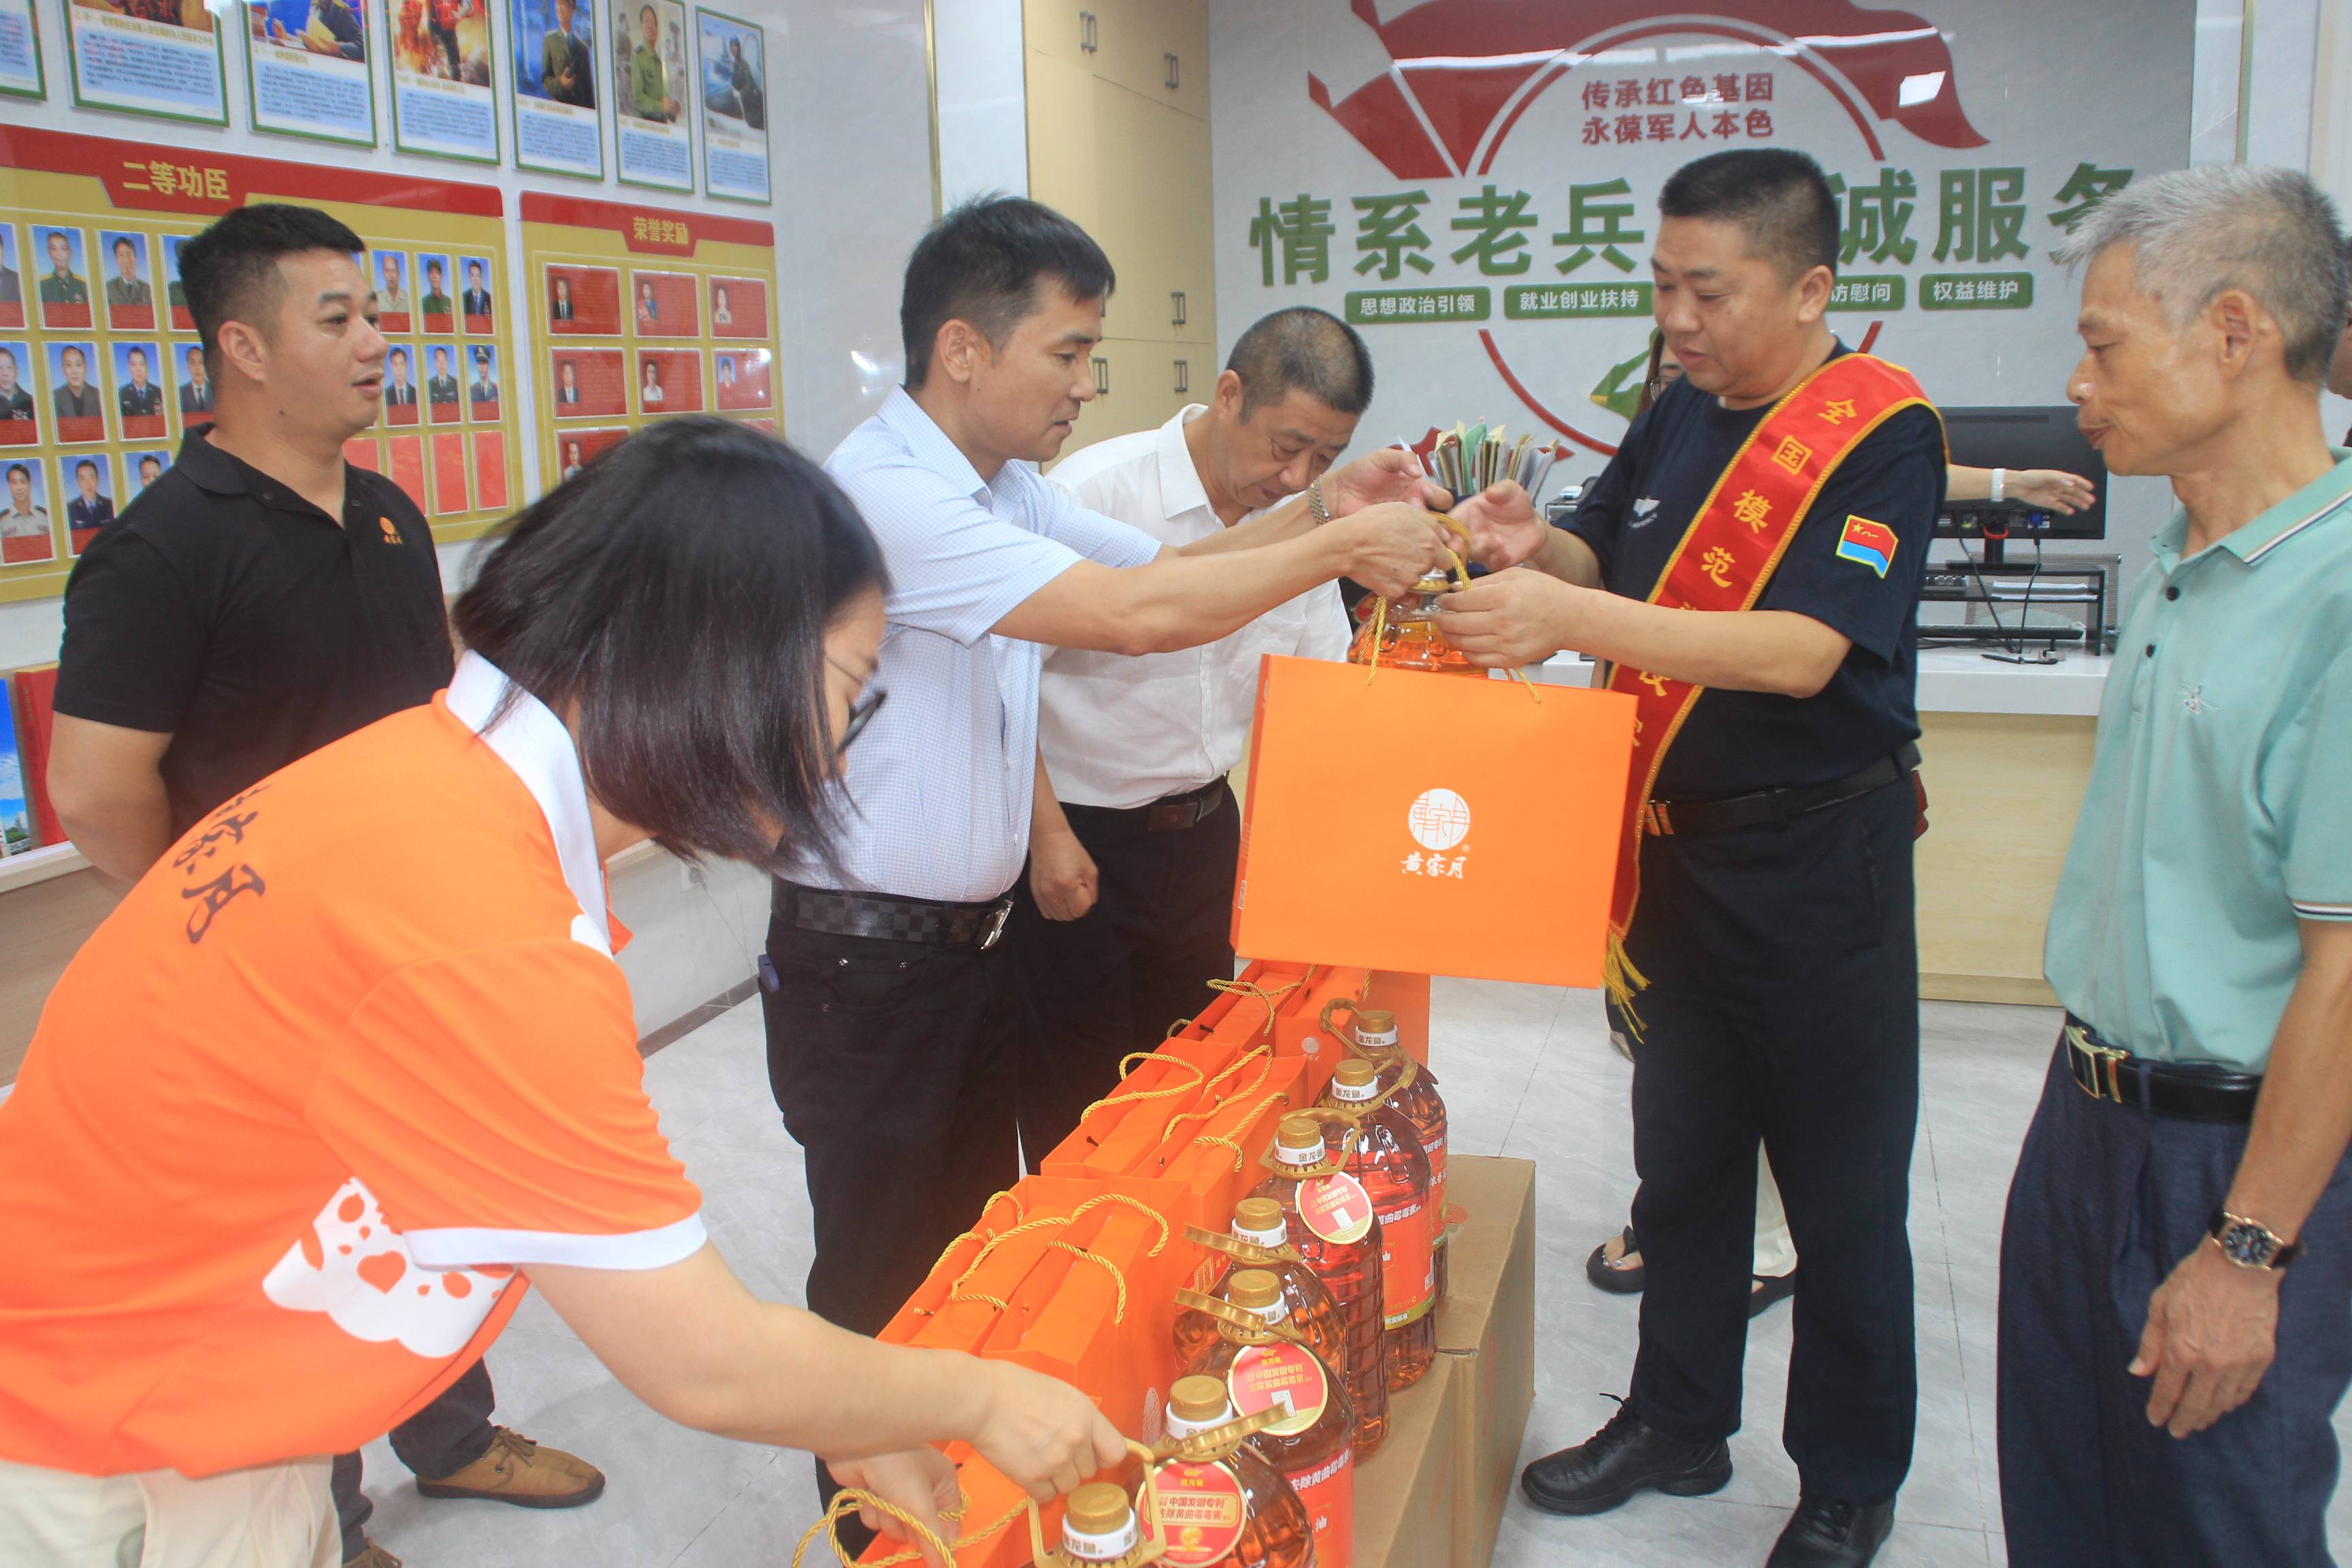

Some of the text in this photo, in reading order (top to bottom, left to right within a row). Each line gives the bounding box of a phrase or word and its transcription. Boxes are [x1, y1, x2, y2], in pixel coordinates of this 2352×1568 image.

[1582, 73, 1774, 110] 传承红色基因
[1582, 108, 1774, 145] 永葆军人本色
[122, 159, 229, 200] 二等功臣
[632, 216, 690, 245] 荣誉奖励
[1250, 176, 1645, 287] 情系老兵
[1519, 289, 1639, 310] 就业创业扶持
[1932, 280, 2019, 301] 权益维护
[1360, 293, 1476, 315] 思想政治引领
[1678, 397, 1858, 610] 全国模范
[1399, 851, 1468, 879] 黄家月
[1358, 1034, 1382, 1045] 金龙鱼
[1335, 1088, 1360, 1098] 金龙鱼
[1298, 1148, 1324, 1162] 金龙鱼
[1169, 1497, 1225, 1509] 中国发明专利
